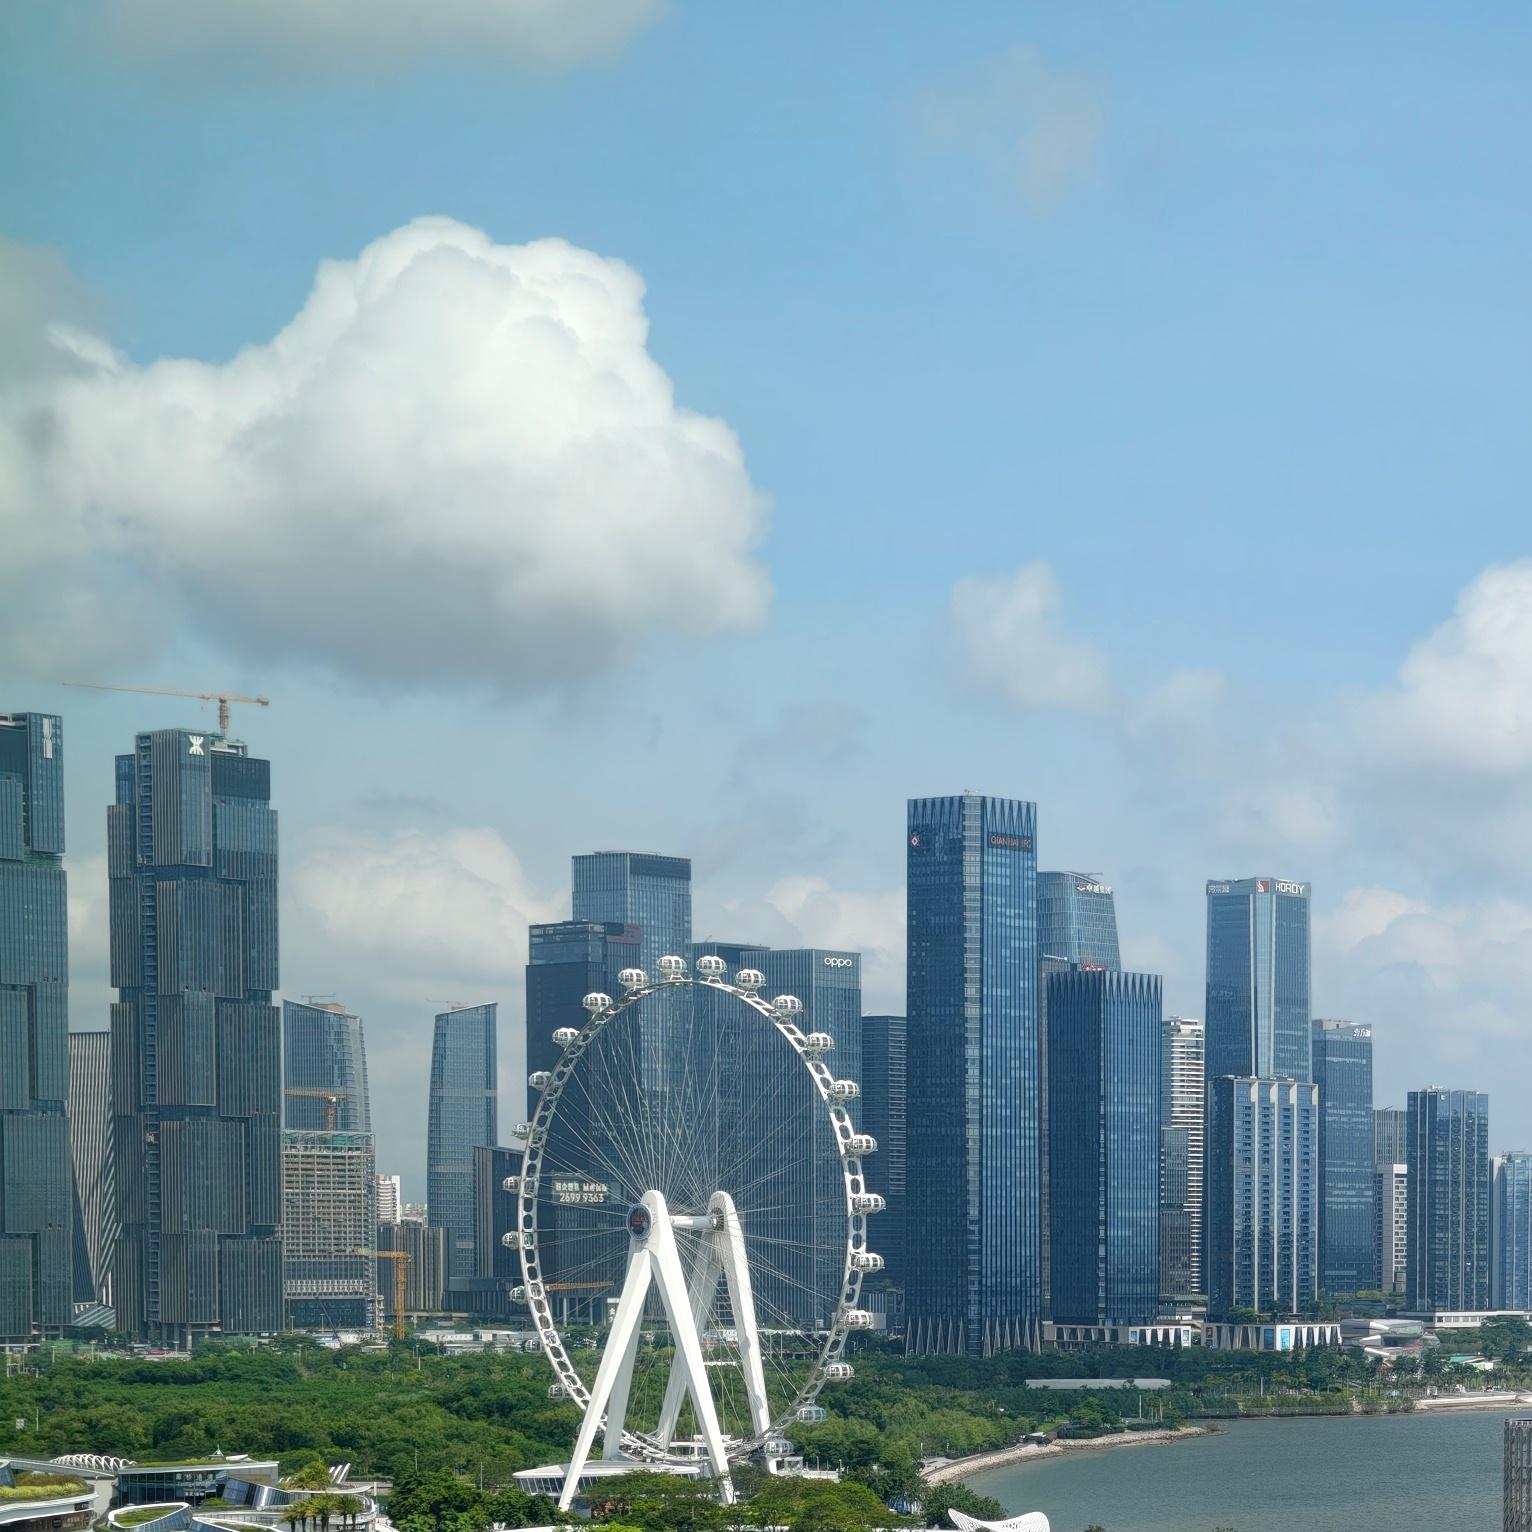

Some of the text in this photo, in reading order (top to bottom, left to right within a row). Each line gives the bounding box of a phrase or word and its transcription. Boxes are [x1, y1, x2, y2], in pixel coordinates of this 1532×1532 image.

[1275, 882, 1305, 895] HORDY
[824, 957, 852, 968] oppo
[559, 1193, 580, 1203] 2699
